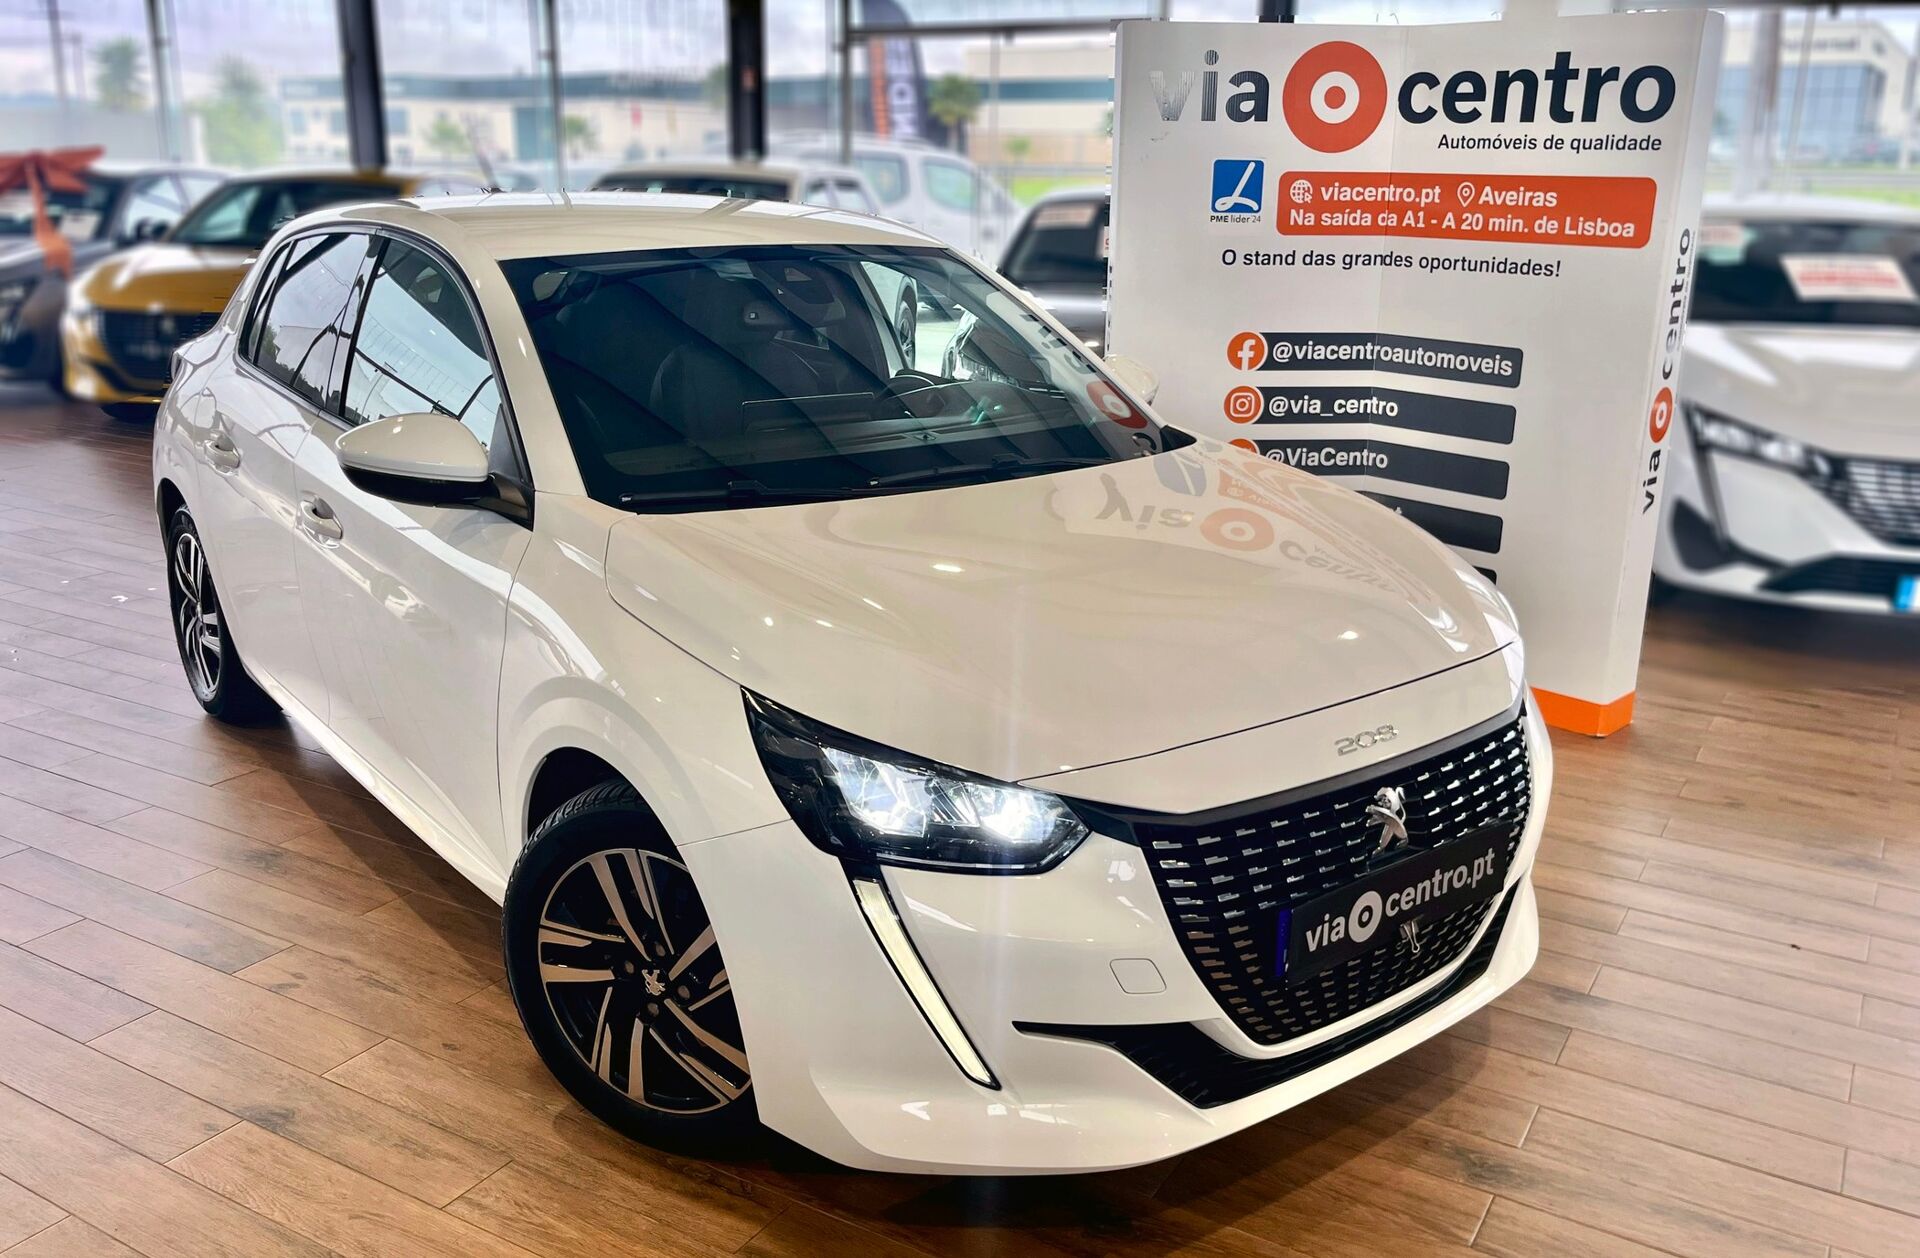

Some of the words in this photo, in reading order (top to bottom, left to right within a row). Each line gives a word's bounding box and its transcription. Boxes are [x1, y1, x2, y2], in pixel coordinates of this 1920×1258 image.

[1149, 49, 1270, 123] via
[1397, 51, 1676, 125] centro
[1437, 134, 1538, 150] Automóveis
[1543, 135, 1565, 150] de
[1569, 135, 1662, 154] qualidade
[1320, 182, 1441, 207] viacentro.pt
[1478, 186, 1558, 207] Aveiras
[1209, 215, 1229, 223] PME
[1289, 209, 1315, 226] Na
[1320, 209, 1373, 226] saída
[1377, 210, 1397, 227] da
[1402, 211, 1425, 228] A1
[1441, 212, 1456, 229] A
[1461, 213, 1483, 231] 20
[1488, 214, 1529, 233] min.
[1534, 216, 1559, 234] de
[1564, 217, 1635, 238] Lisboa
[1221, 249, 1237, 266] O
[1243, 250, 1296, 266] stand
[1302, 250, 1336, 266] das
[1342, 251, 1413, 270] grandes
[1418, 256, 1561, 278] oportunidades!
[1272, 340, 1513, 377] @viacentroautomoveis
[1268, 395, 1399, 417] @via_centro
[1265, 447, 1388, 469] @ViaCentro
[1643, 449, 1662, 515] via
[1334, 723, 1399, 757] 208
[1305, 913, 1345, 953] via
[1384, 847, 1496, 918] centro.pt
